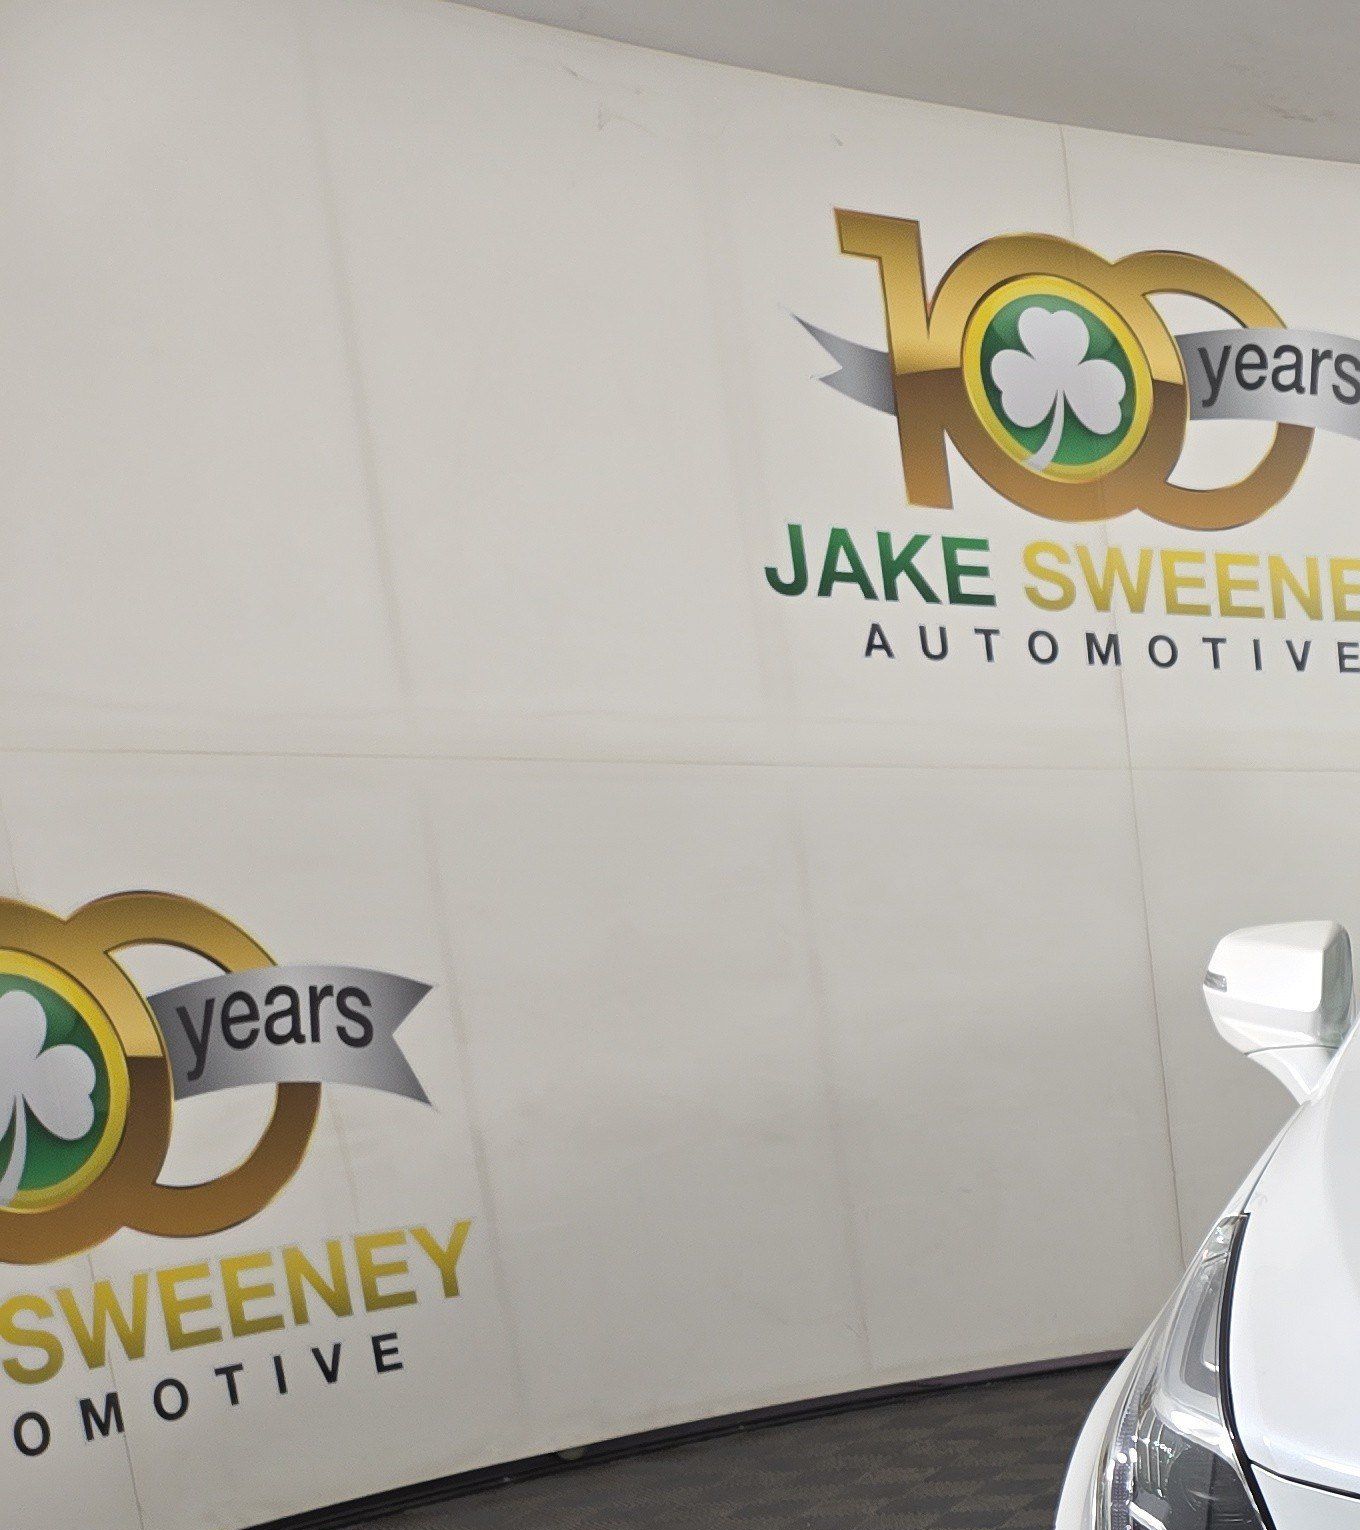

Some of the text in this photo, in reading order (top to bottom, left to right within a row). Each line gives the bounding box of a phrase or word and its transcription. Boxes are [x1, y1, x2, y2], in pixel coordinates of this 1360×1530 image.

[833, 207, 1316, 531] 100
[765, 523, 997, 608] JAKE
[176, 983, 375, 1080] years
[0, 1221, 472, 1385] SWEENEY
[13, 1332, 403, 1457] OMOTIVE
